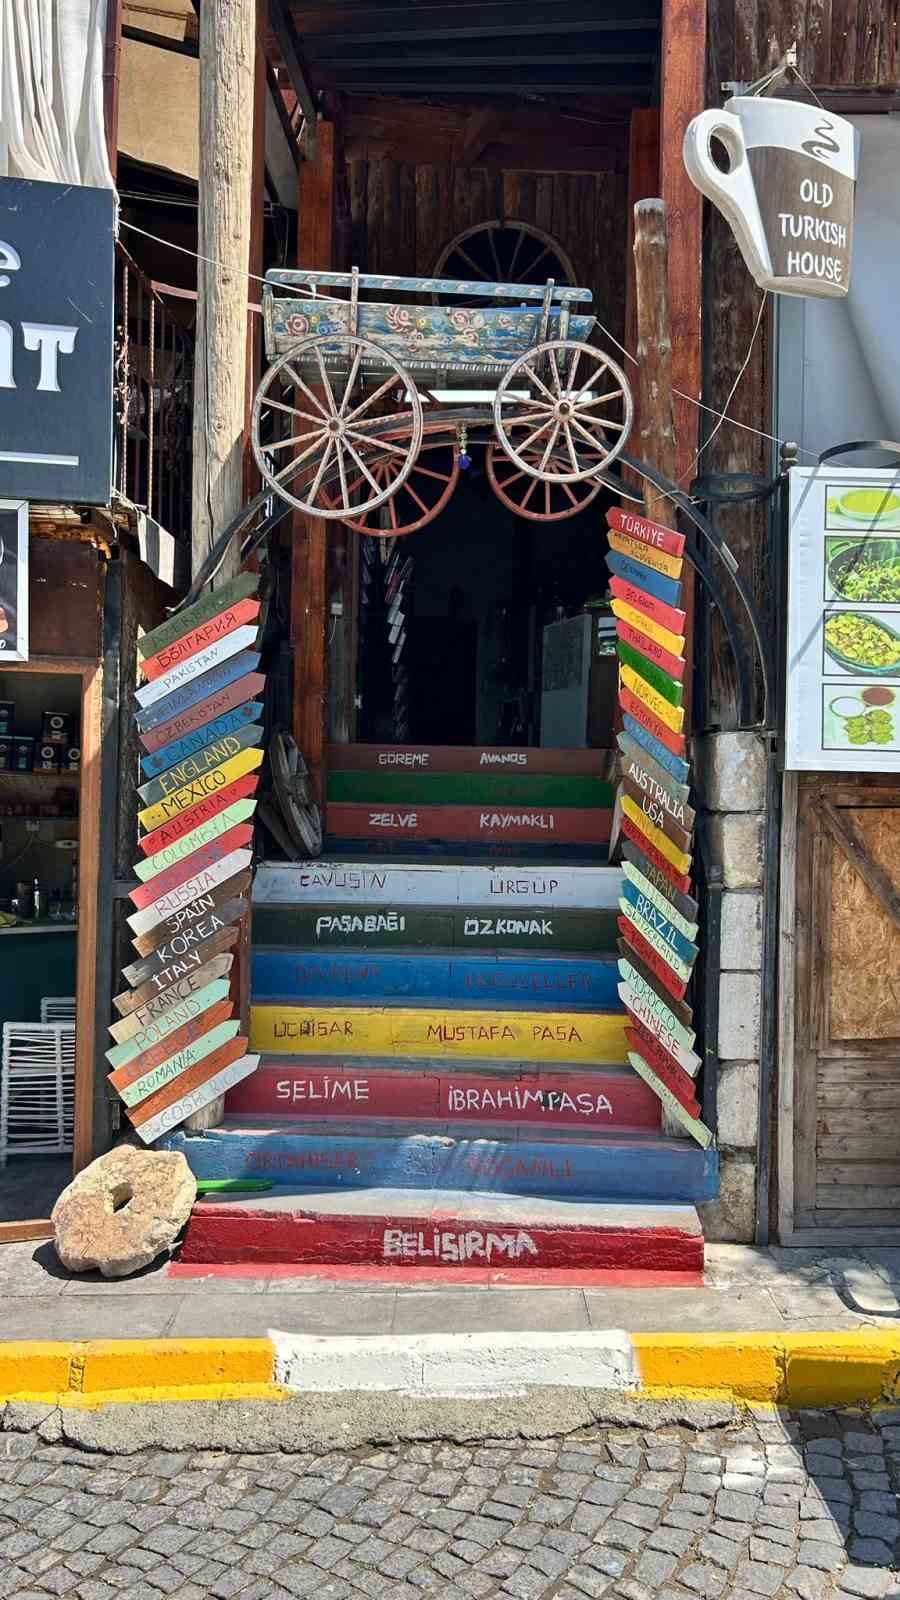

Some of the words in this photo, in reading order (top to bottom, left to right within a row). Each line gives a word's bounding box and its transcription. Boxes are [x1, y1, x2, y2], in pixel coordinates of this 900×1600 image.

[800, 179, 833, 208] OLD
[778, 213, 846, 248] TURKISH
[787, 251, 842, 281] HOUSE
[166, 716, 241, 762] CANADA
[479, 751, 528, 766] AVANOS
[159, 737, 241, 795] ENGLAND
[628, 763, 685, 826] AUSTRALIA
[641, 796, 664, 829] USA
[368, 811, 417, 828] ZELVE
[479, 812, 555, 831] KAYMAKLI
[154, 871, 218, 917] RUSSIA
[156, 914, 225, 964] KOREA
[636, 895, 680, 951] BRAZIL
[628, 968, 676, 1031] MOROCCO
[135, 999, 201, 1051] POLAND
[427, 1023, 515, 1043] MUSTAFA
[631, 995, 681, 1057] CHINESE
[136, 1047, 197, 1097] ROMANIA
